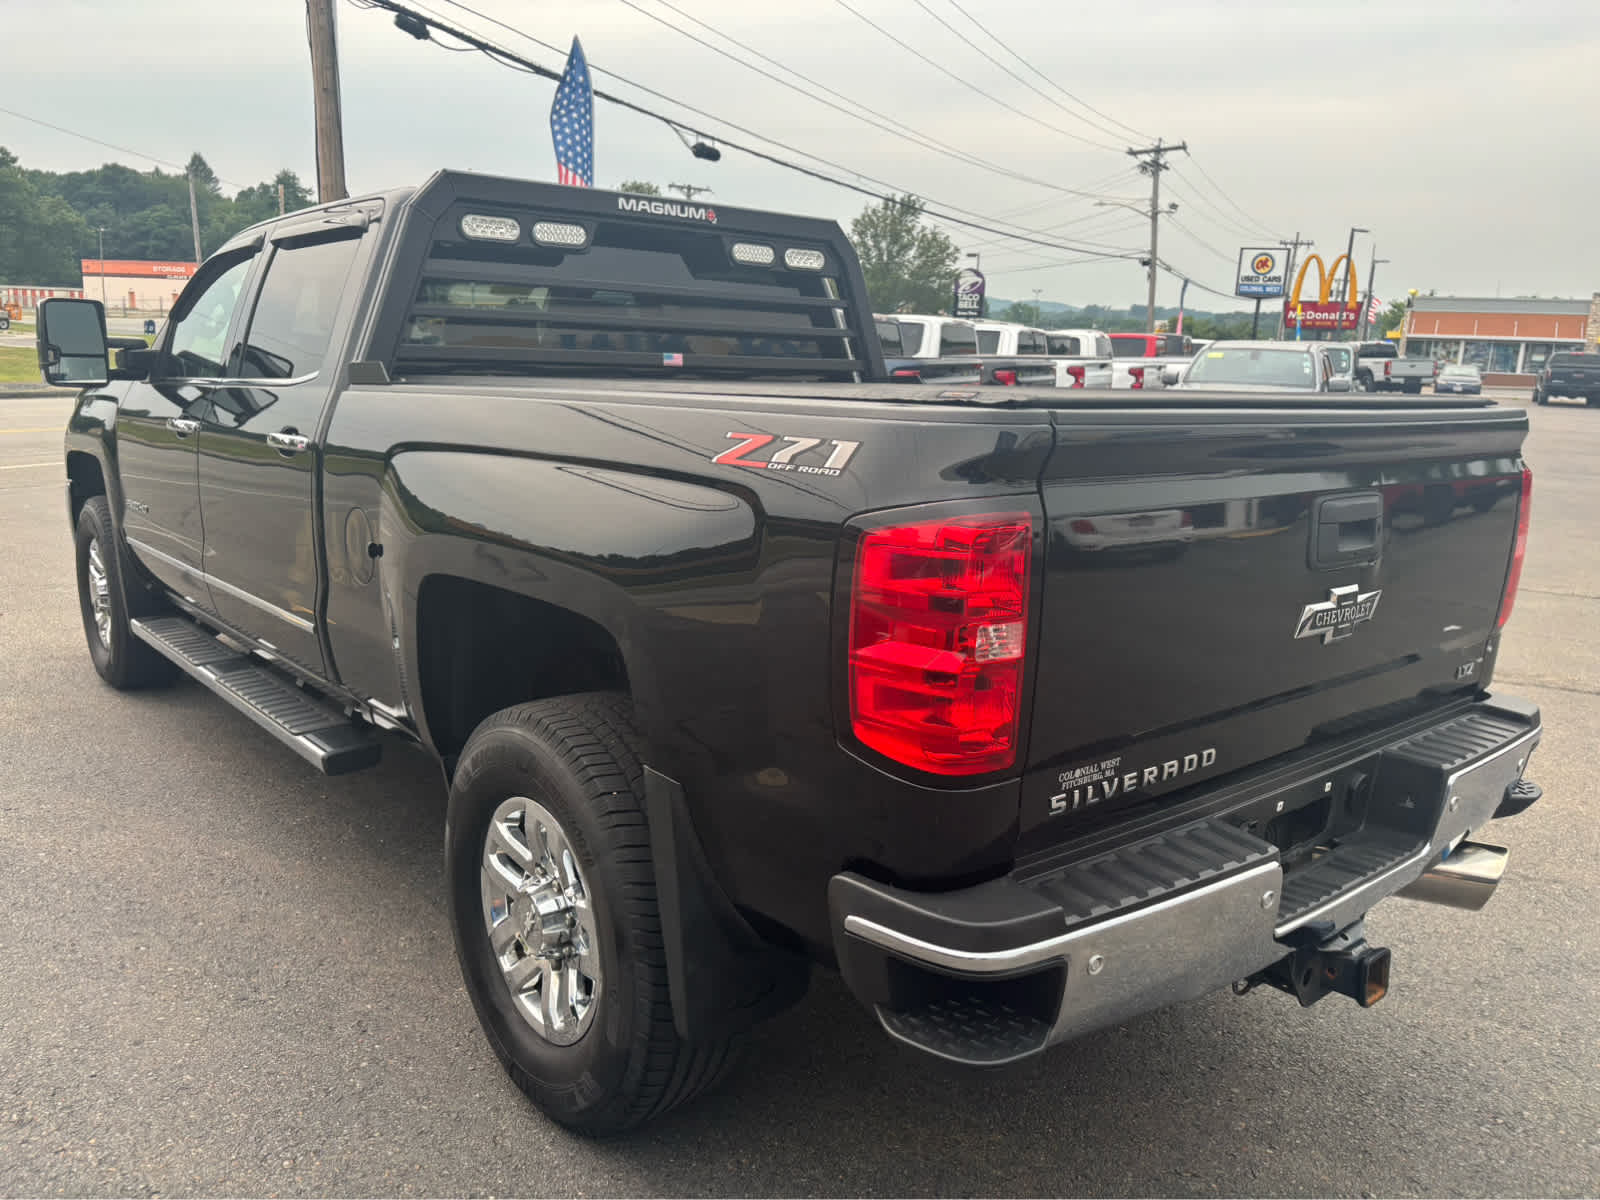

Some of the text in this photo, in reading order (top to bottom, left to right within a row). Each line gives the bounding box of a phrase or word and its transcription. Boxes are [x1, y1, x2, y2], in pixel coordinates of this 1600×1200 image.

[618, 197, 706, 221] MAGNUM
[1262, 275, 1282, 283] CARS
[958, 301, 980, 309] BELL
[711, 432, 861, 470] Z71
[768, 462, 842, 477] OFF ROAD
[1315, 602, 1371, 626] CHEVROLET
[1049, 747, 1216, 816] SILVERADO
[1058, 756, 1122, 783] COLONIAL WEST
